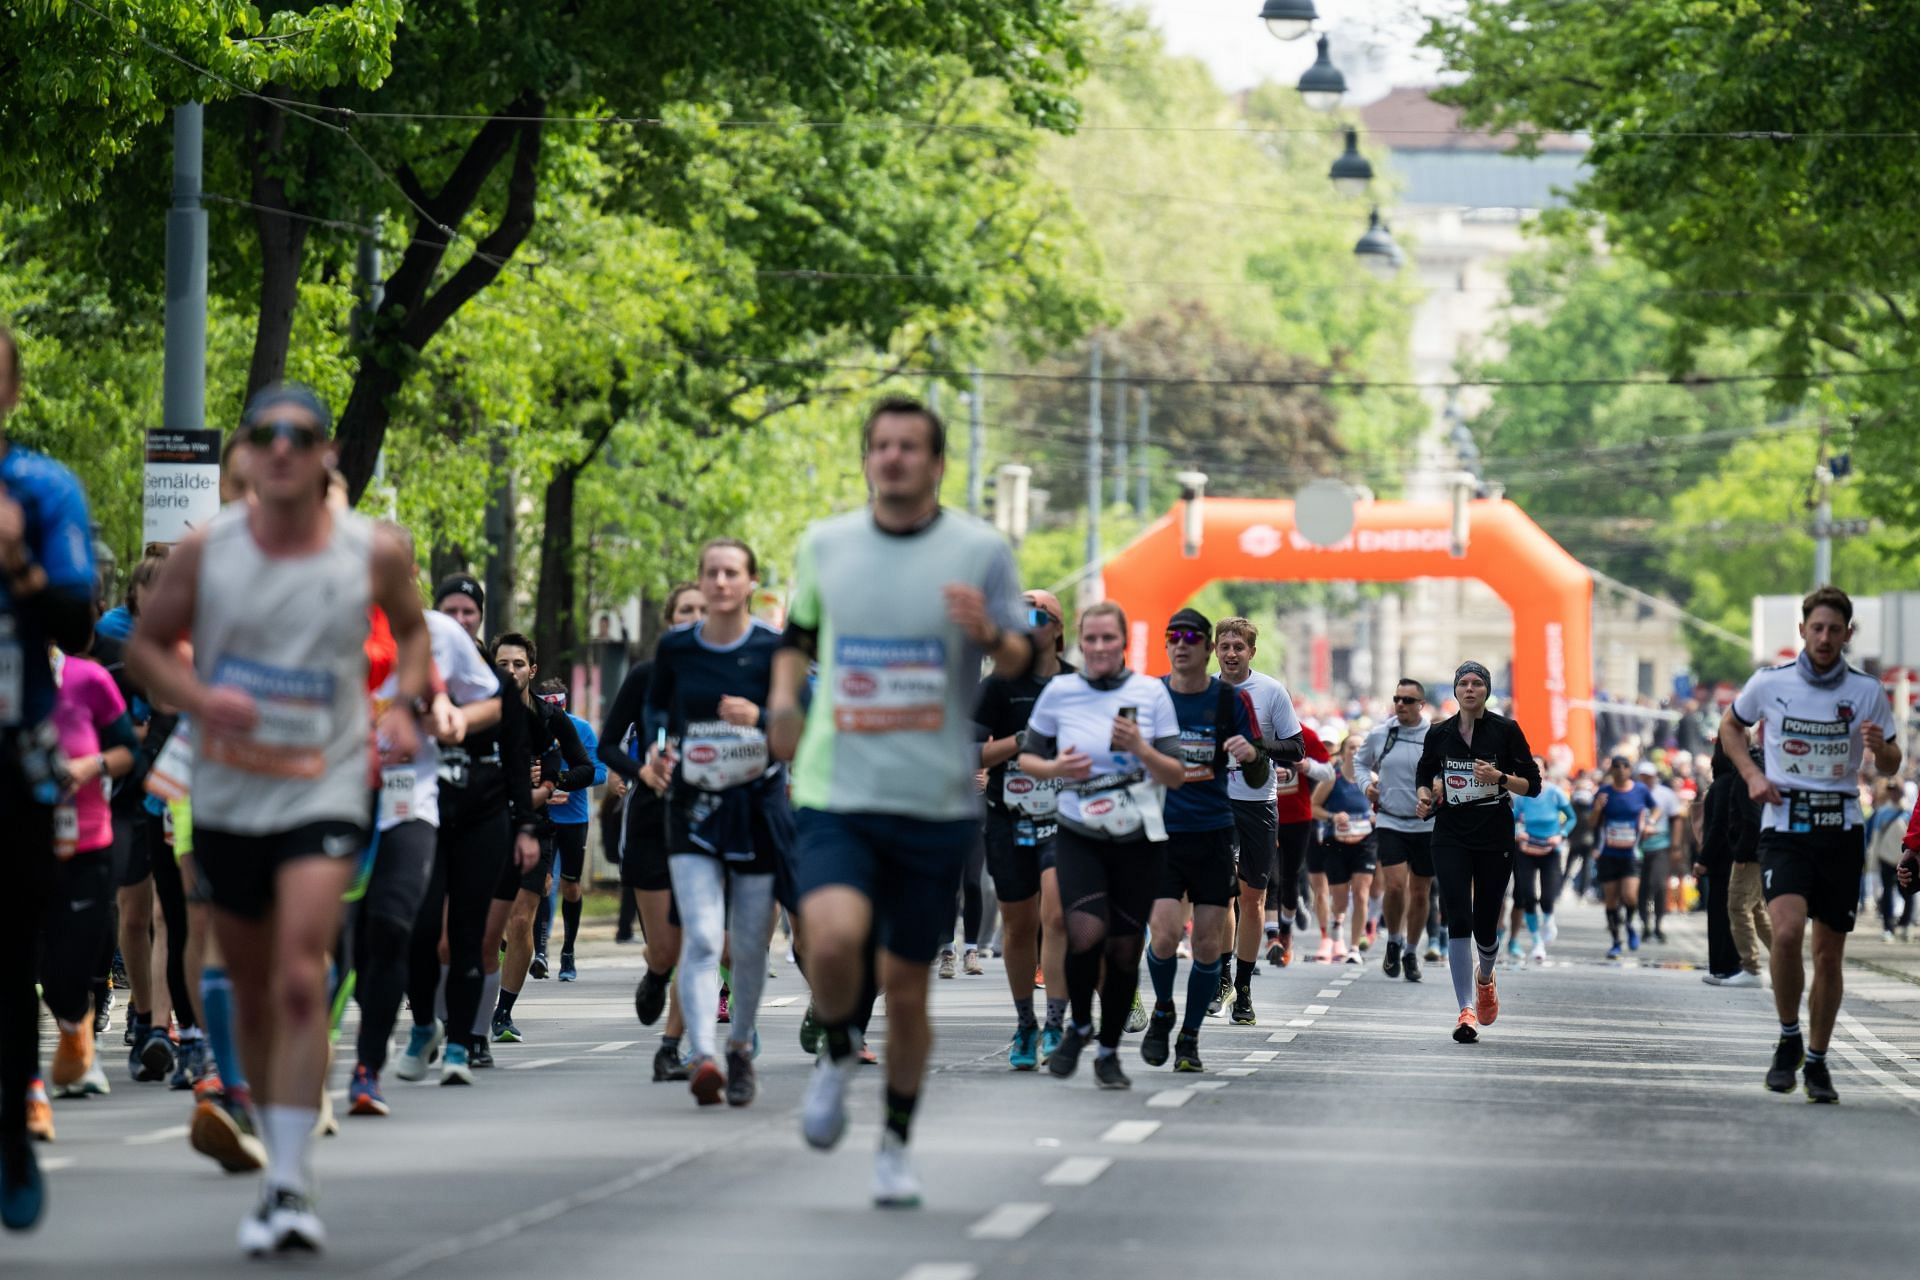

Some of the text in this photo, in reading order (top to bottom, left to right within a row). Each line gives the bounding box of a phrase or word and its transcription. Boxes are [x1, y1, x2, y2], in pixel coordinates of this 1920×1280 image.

[1358, 528, 1470, 553] ENERGI
[1784, 719, 1848, 735] POWERADE
[1447, 760, 1497, 771] POWEE
